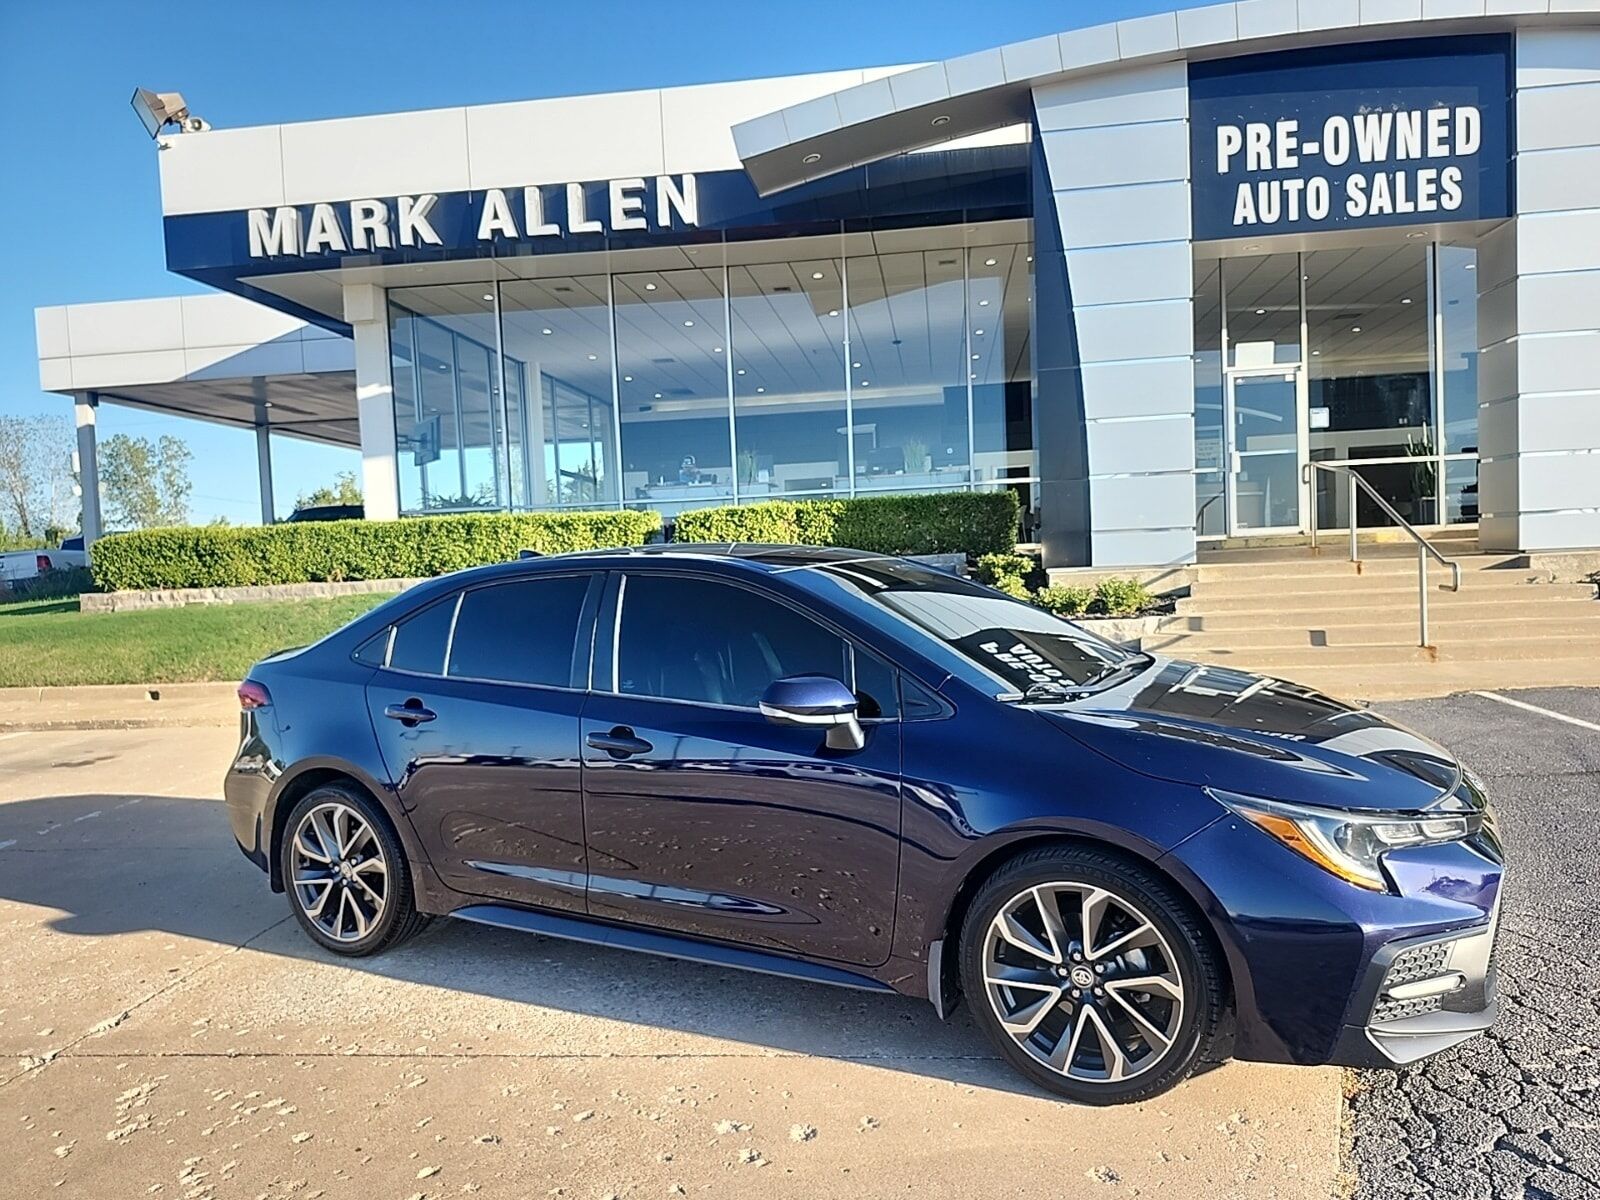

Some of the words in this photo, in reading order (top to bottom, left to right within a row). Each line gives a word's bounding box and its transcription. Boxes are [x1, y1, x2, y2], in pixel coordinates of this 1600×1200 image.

[1216, 106, 1481, 173] PRE-OWNED
[248, 195, 443, 258] MARK
[476, 174, 699, 240] ALLEN
[1233, 176, 1330, 225] AUTO
[1346, 166, 1463, 217] SALES
